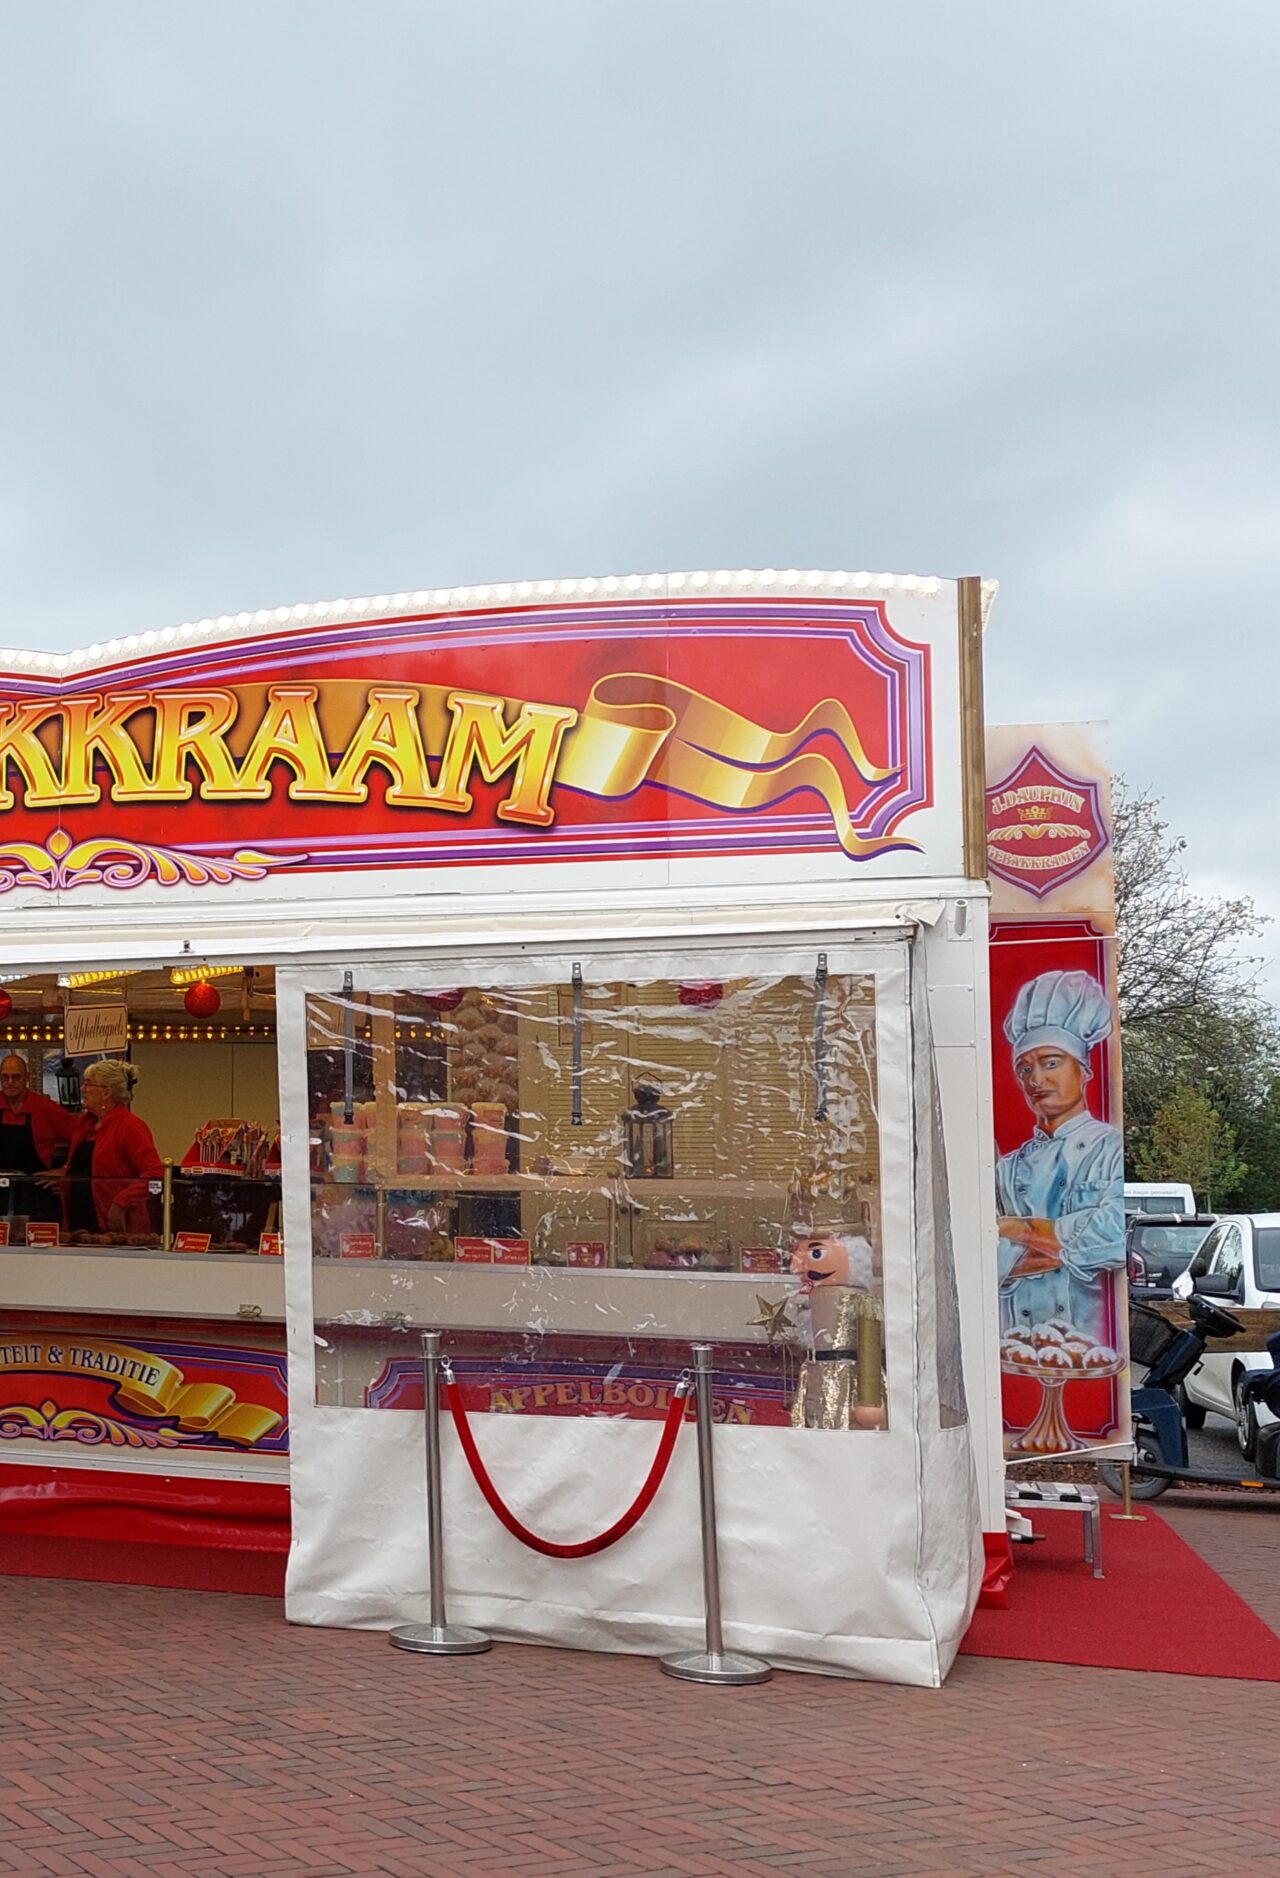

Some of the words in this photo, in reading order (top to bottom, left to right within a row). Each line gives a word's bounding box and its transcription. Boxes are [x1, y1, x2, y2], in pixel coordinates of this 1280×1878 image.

[986, 840, 1091, 870] GEBAKKRAMEN
[47, 1345, 63, 1364] &
[70, 1347, 161, 1386] TRADITIE
